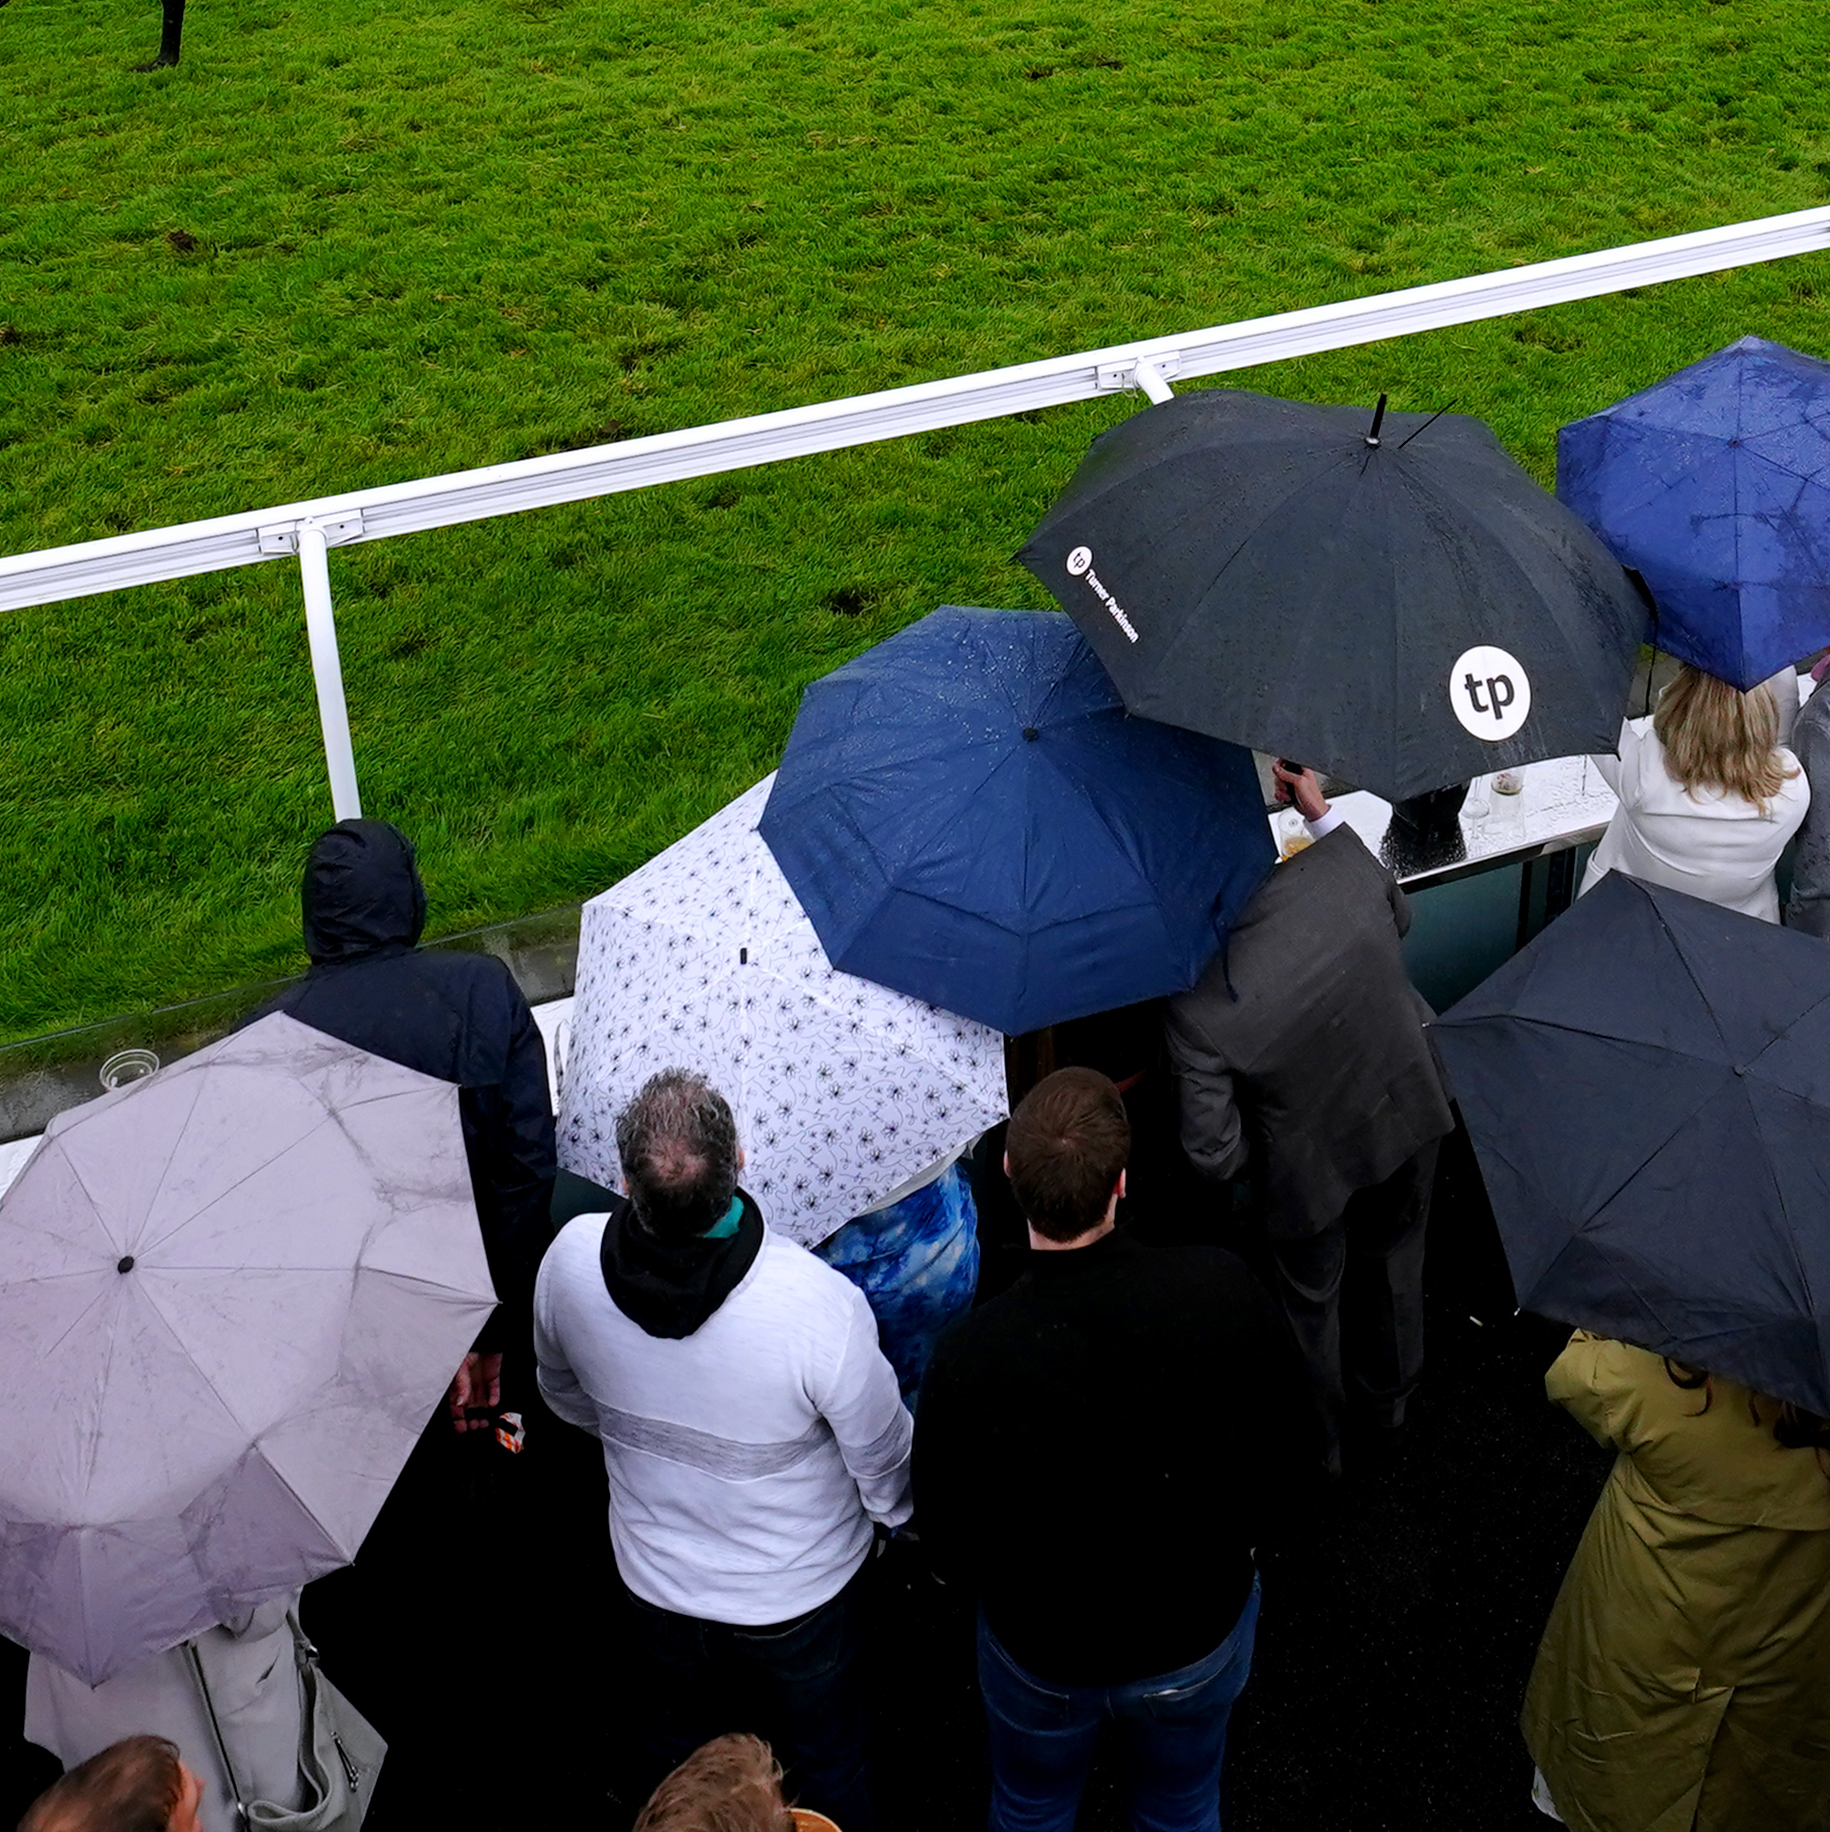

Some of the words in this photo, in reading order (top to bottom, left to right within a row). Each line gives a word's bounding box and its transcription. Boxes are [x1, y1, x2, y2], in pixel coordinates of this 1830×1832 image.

[1073, 551, 1086, 568] tp
[1085, 568, 1110, 601] Turner
[1105, 596, 1139, 644] Parkinson
[1464, 672, 1515, 720] tp
